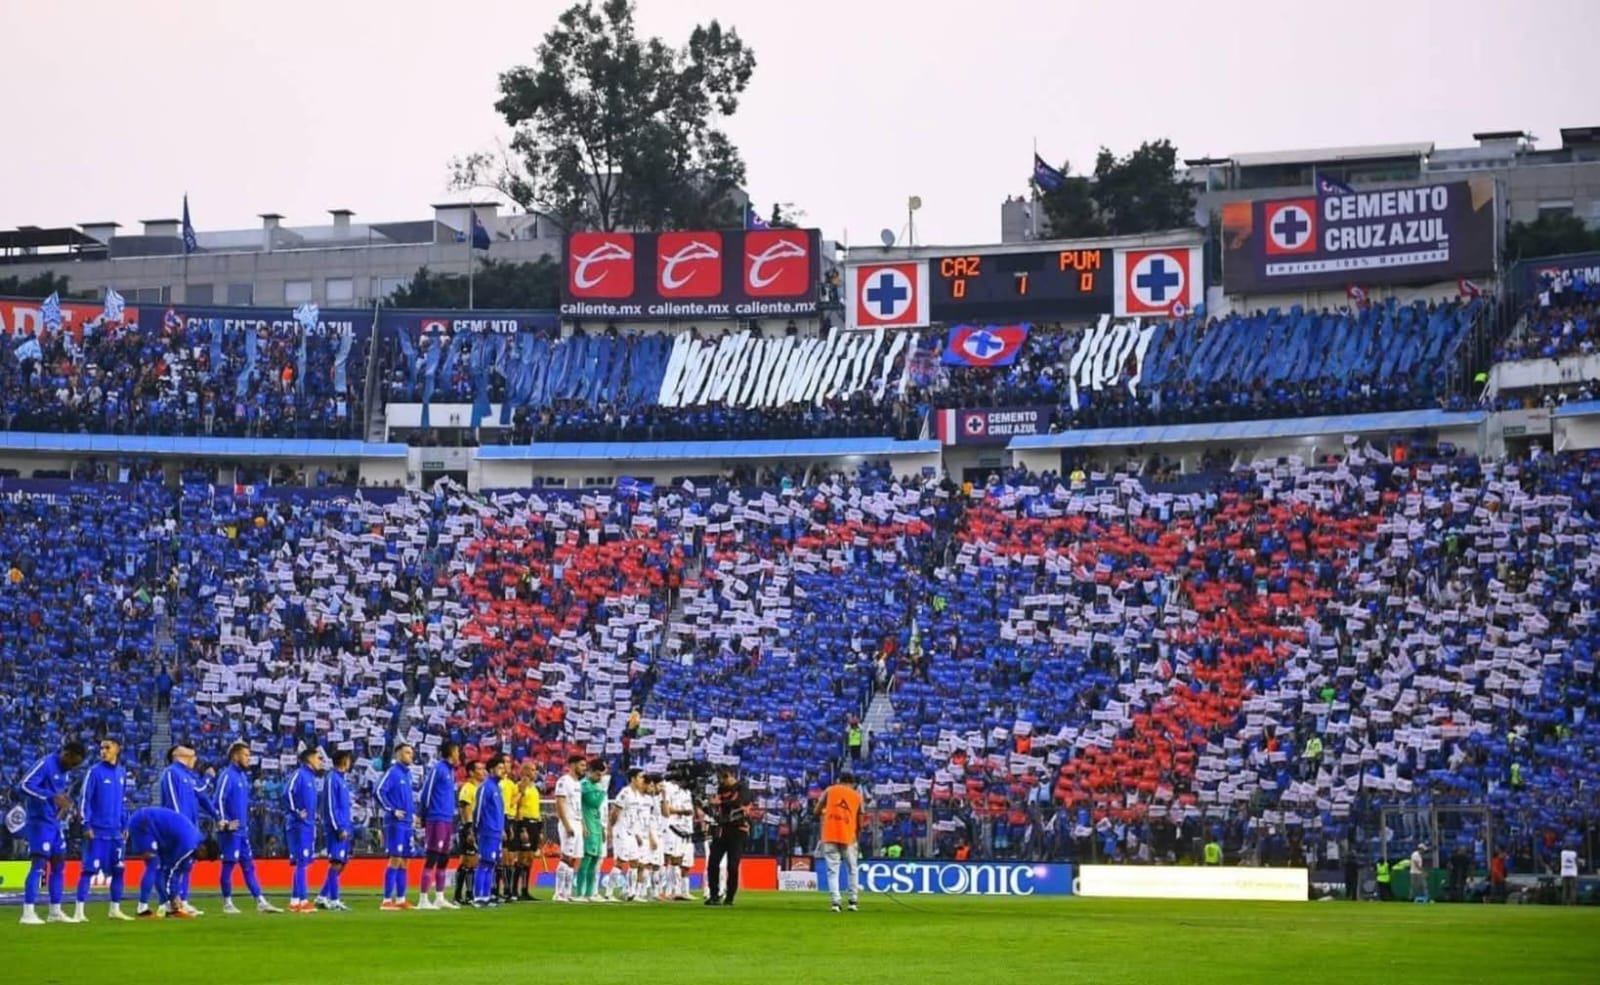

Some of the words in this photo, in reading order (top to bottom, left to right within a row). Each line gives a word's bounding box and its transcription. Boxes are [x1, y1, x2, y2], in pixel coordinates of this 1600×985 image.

[1324, 186, 1449, 222] CEMENTO
[1325, 223, 1386, 251] CRUZ
[1389, 218, 1449, 246] AZUL
[940, 257, 981, 277] CAZ
[1059, 250, 1101, 271] PUM
[953, 279, 966, 298] 0
[1080, 272, 1094, 292] 0
[560, 301, 642, 315] caliente.mx
[648, 301, 730, 315] caliente.mx
[735, 300, 817, 314] caliente.mx
[987, 411, 1038, 423] CEMENTO
[987, 424, 1013, 435] CRUZ
[1013, 423, 1038, 434] AZUL
